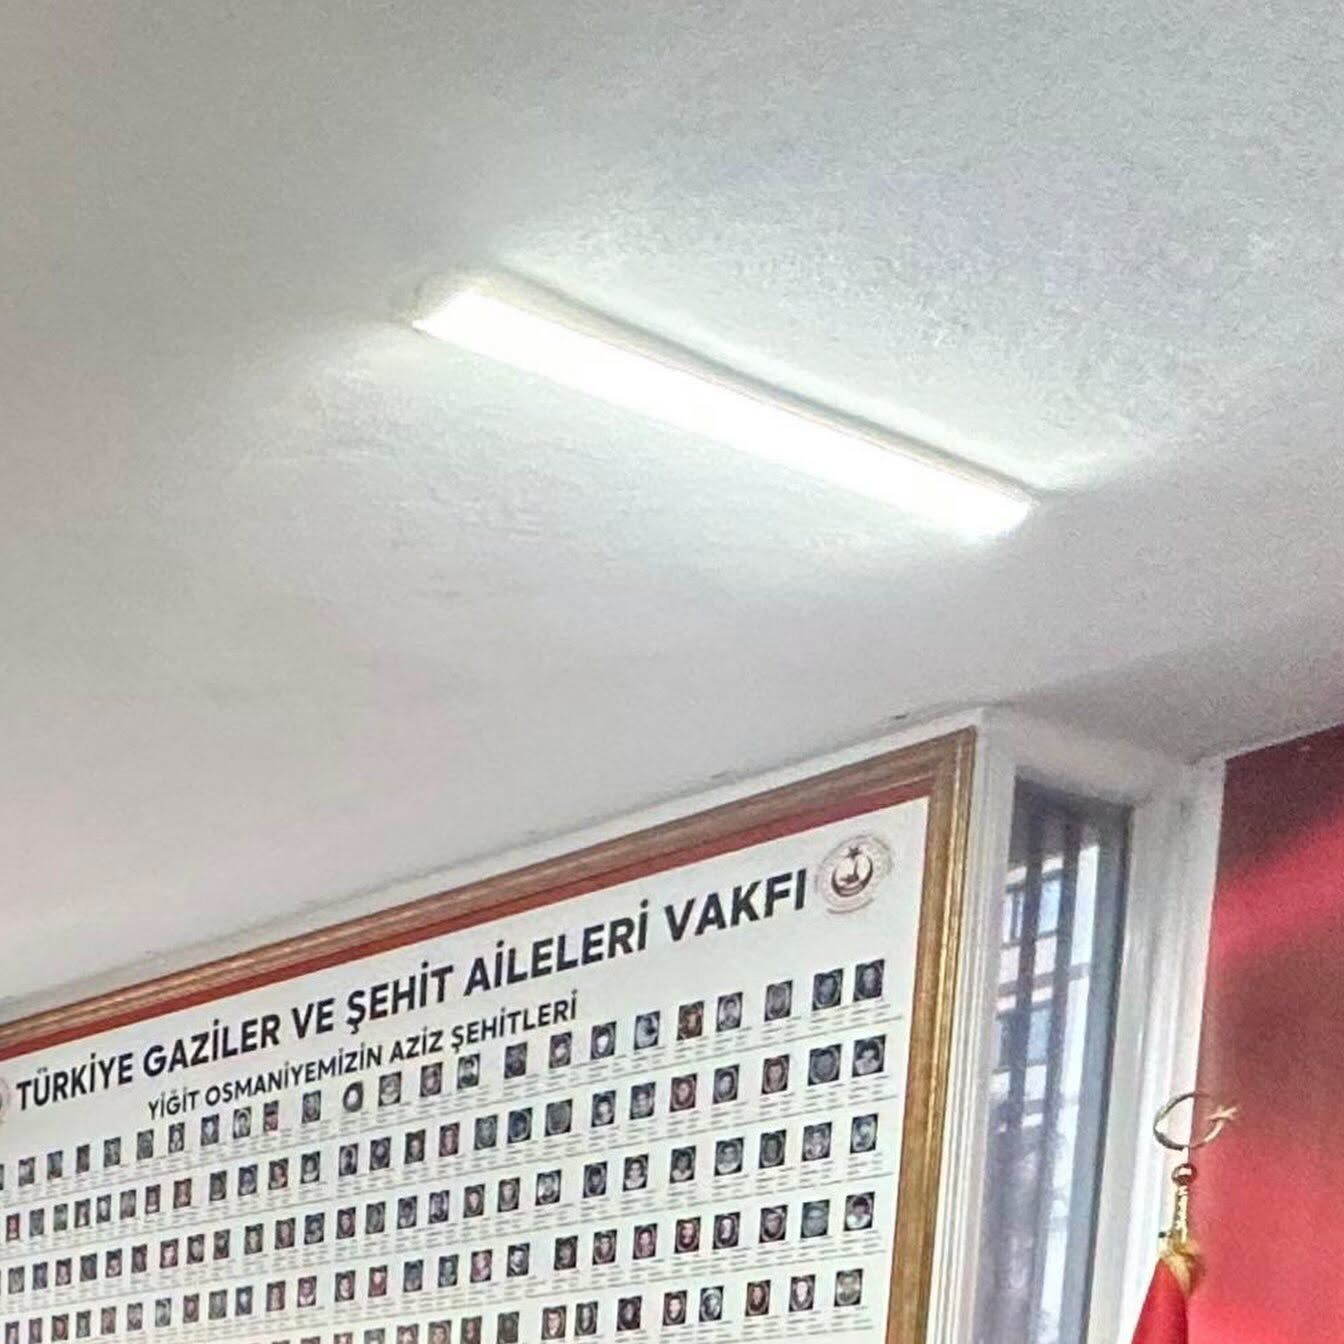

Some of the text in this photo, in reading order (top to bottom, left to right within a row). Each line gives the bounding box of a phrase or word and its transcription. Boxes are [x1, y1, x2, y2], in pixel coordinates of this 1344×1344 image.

[15, 869, 808, 1112] TÜRKİYE GAZİLER VE ŞEHİT AİLELERİ VAKFI
[147, 990, 578, 1121] YİĞİT OSMANİYEMİZİN AZİZ ŞEHİTLERİ
